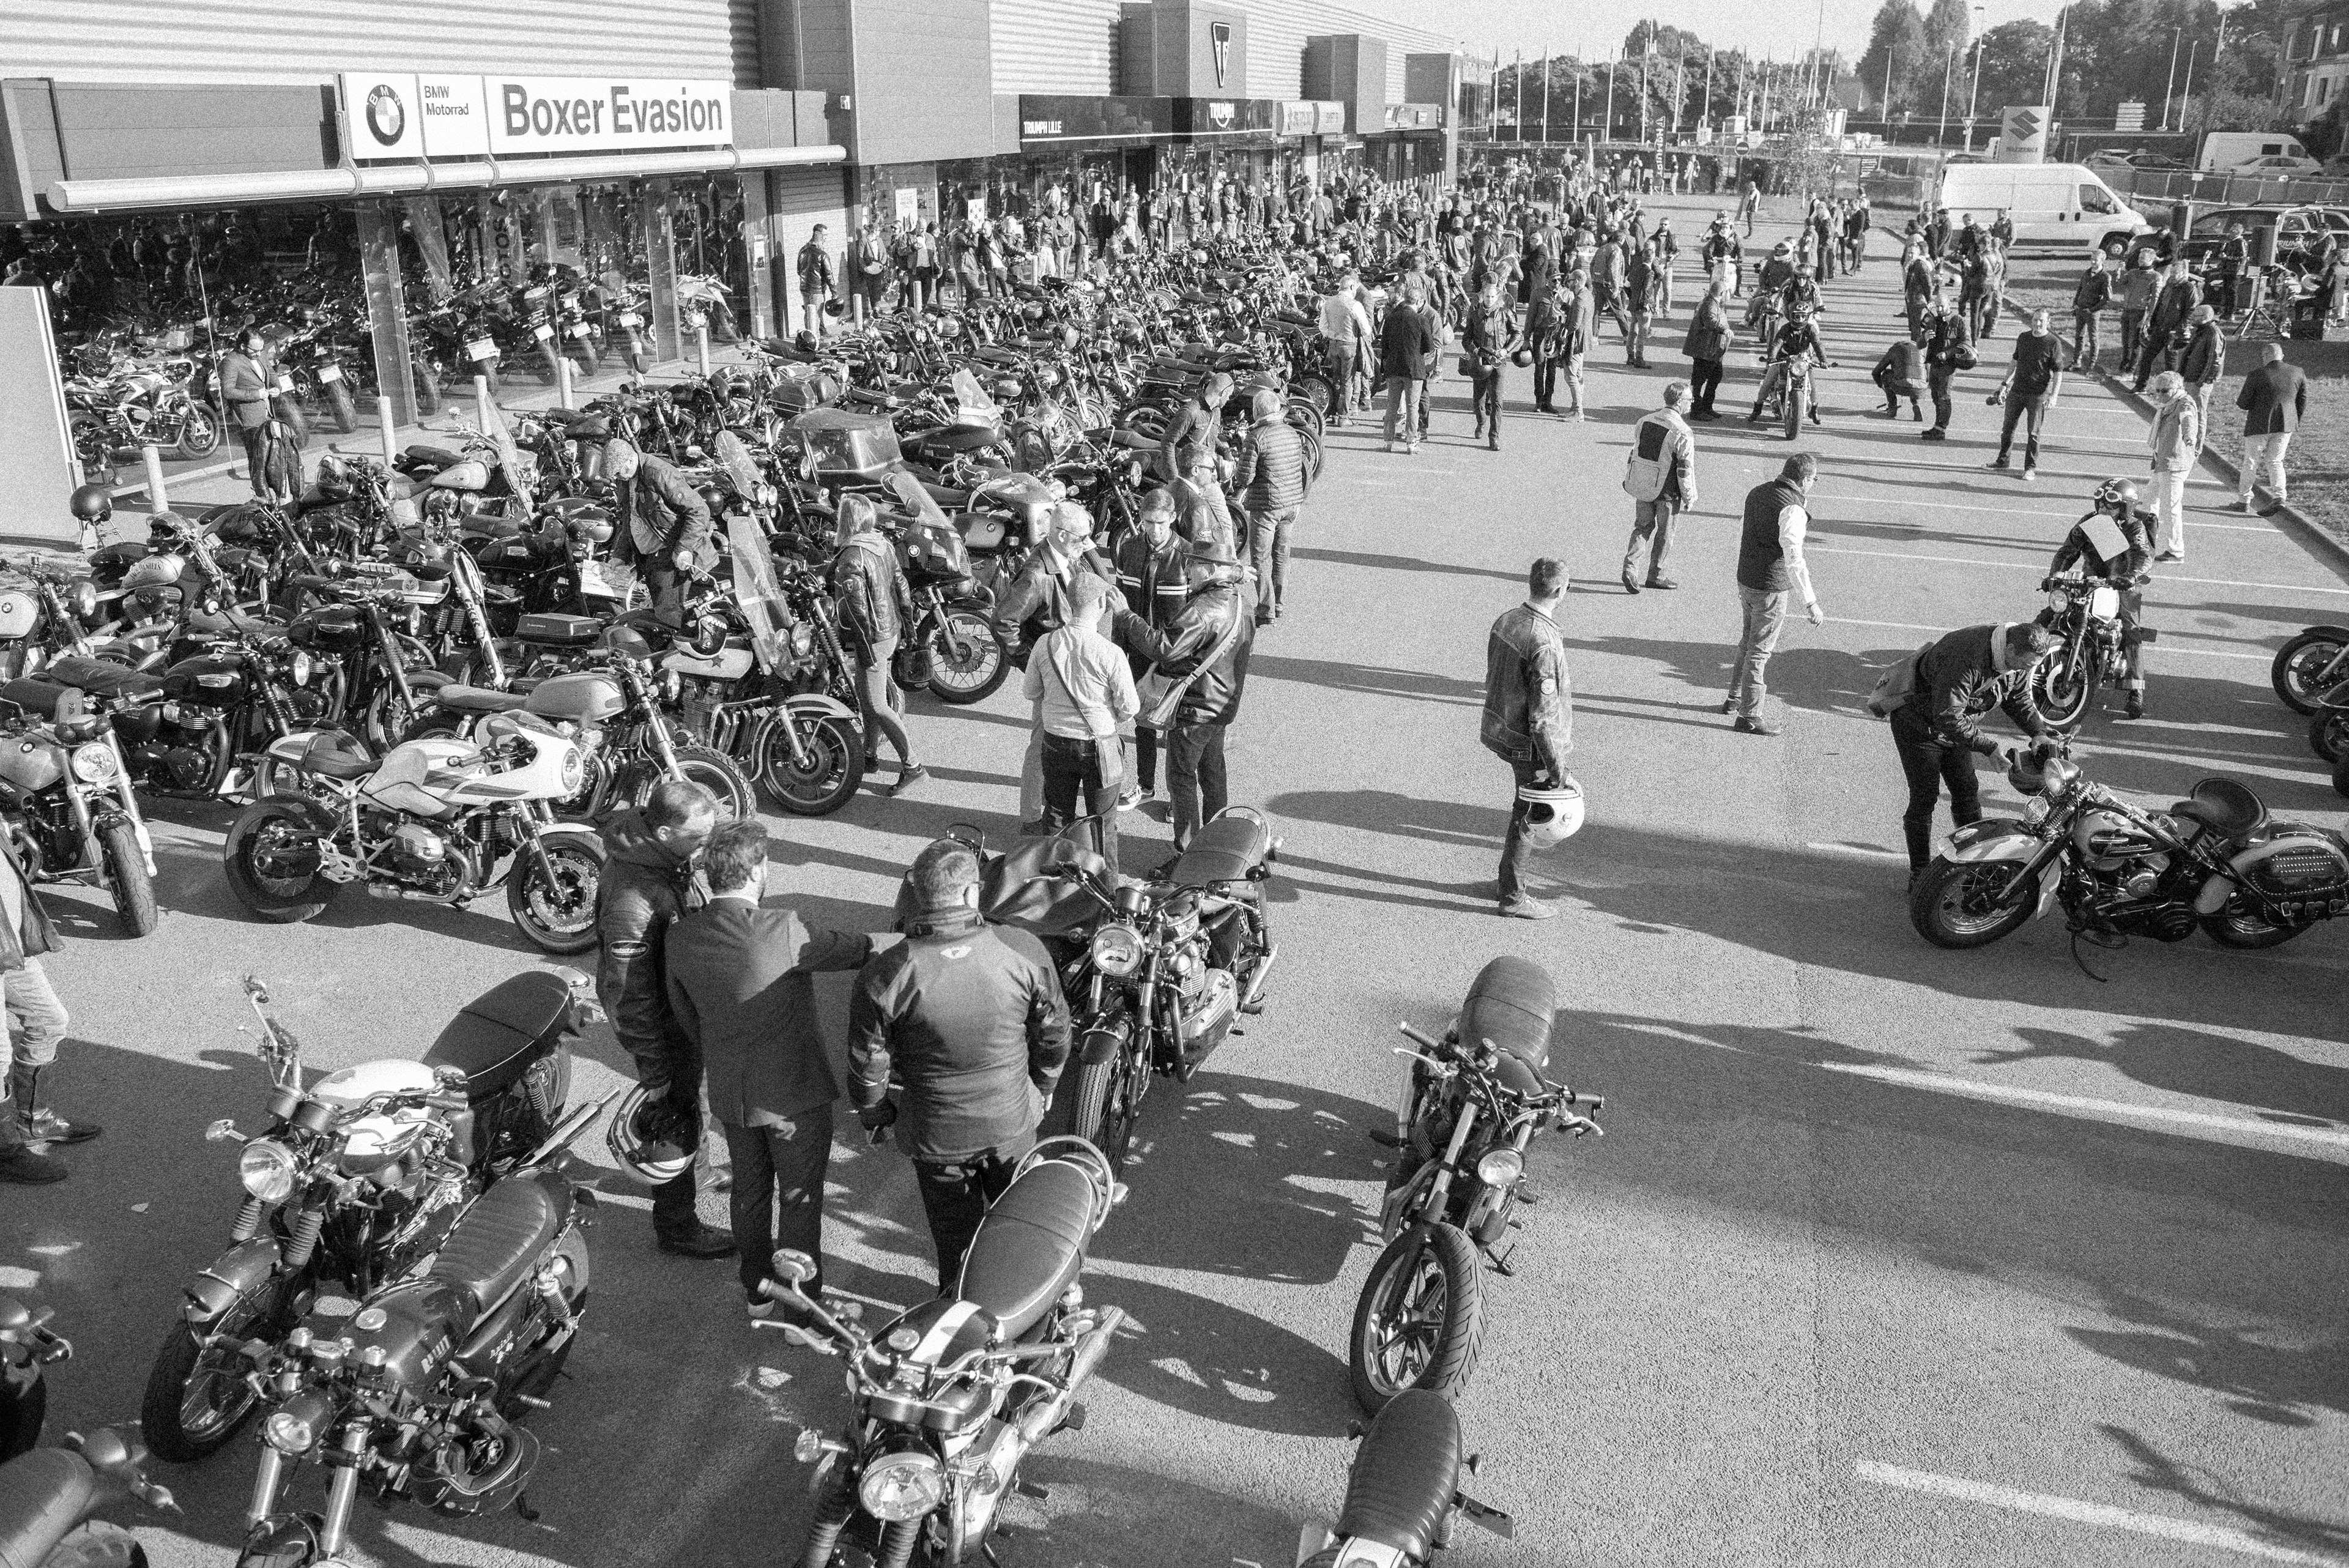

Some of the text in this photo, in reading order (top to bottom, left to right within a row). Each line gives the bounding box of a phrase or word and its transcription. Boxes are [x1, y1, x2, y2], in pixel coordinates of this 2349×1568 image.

[424, 86, 449, 98] BMW
[426, 103, 469, 115] Motorrad
[502, 84, 723, 136] Boxer Evasion
[1209, 103, 1234, 119] TRIUMPH
[1023, 121, 1061, 134] TRIUMPH LILLE
